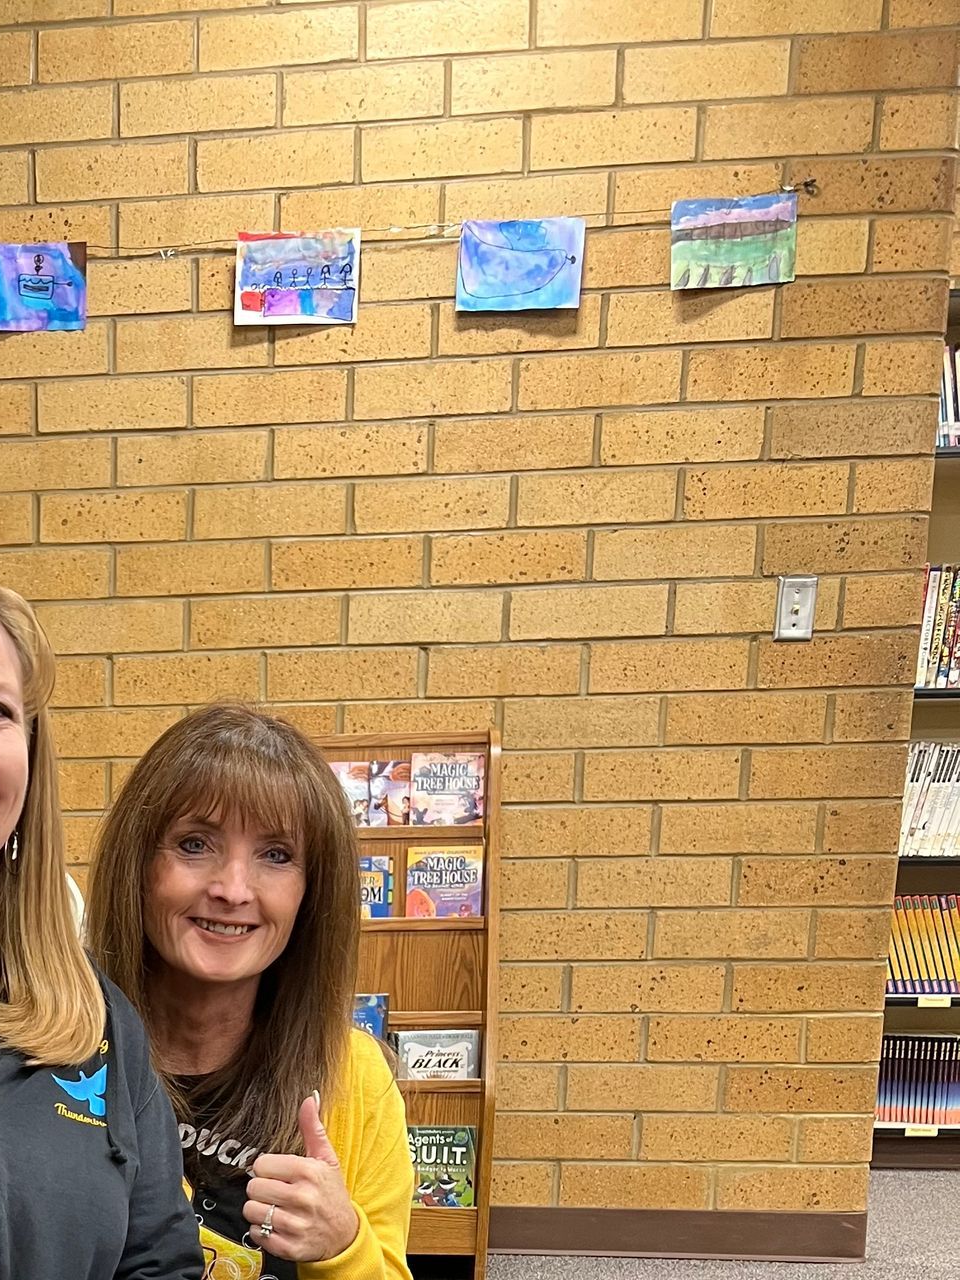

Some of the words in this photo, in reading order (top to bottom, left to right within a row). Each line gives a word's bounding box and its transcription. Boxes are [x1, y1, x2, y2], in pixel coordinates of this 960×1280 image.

[430, 763, 468, 777] MAGIC
[415, 776, 444, 791] TREE
[444, 776, 480, 790] HOUSE
[426, 856, 466, 870] MAGIC
[412, 870, 441, 885] TREE
[441, 869, 478, 884] HOUSE
[411, 1057, 462, 1068] BLACK
[408, 1133, 445, 1147] Agents
